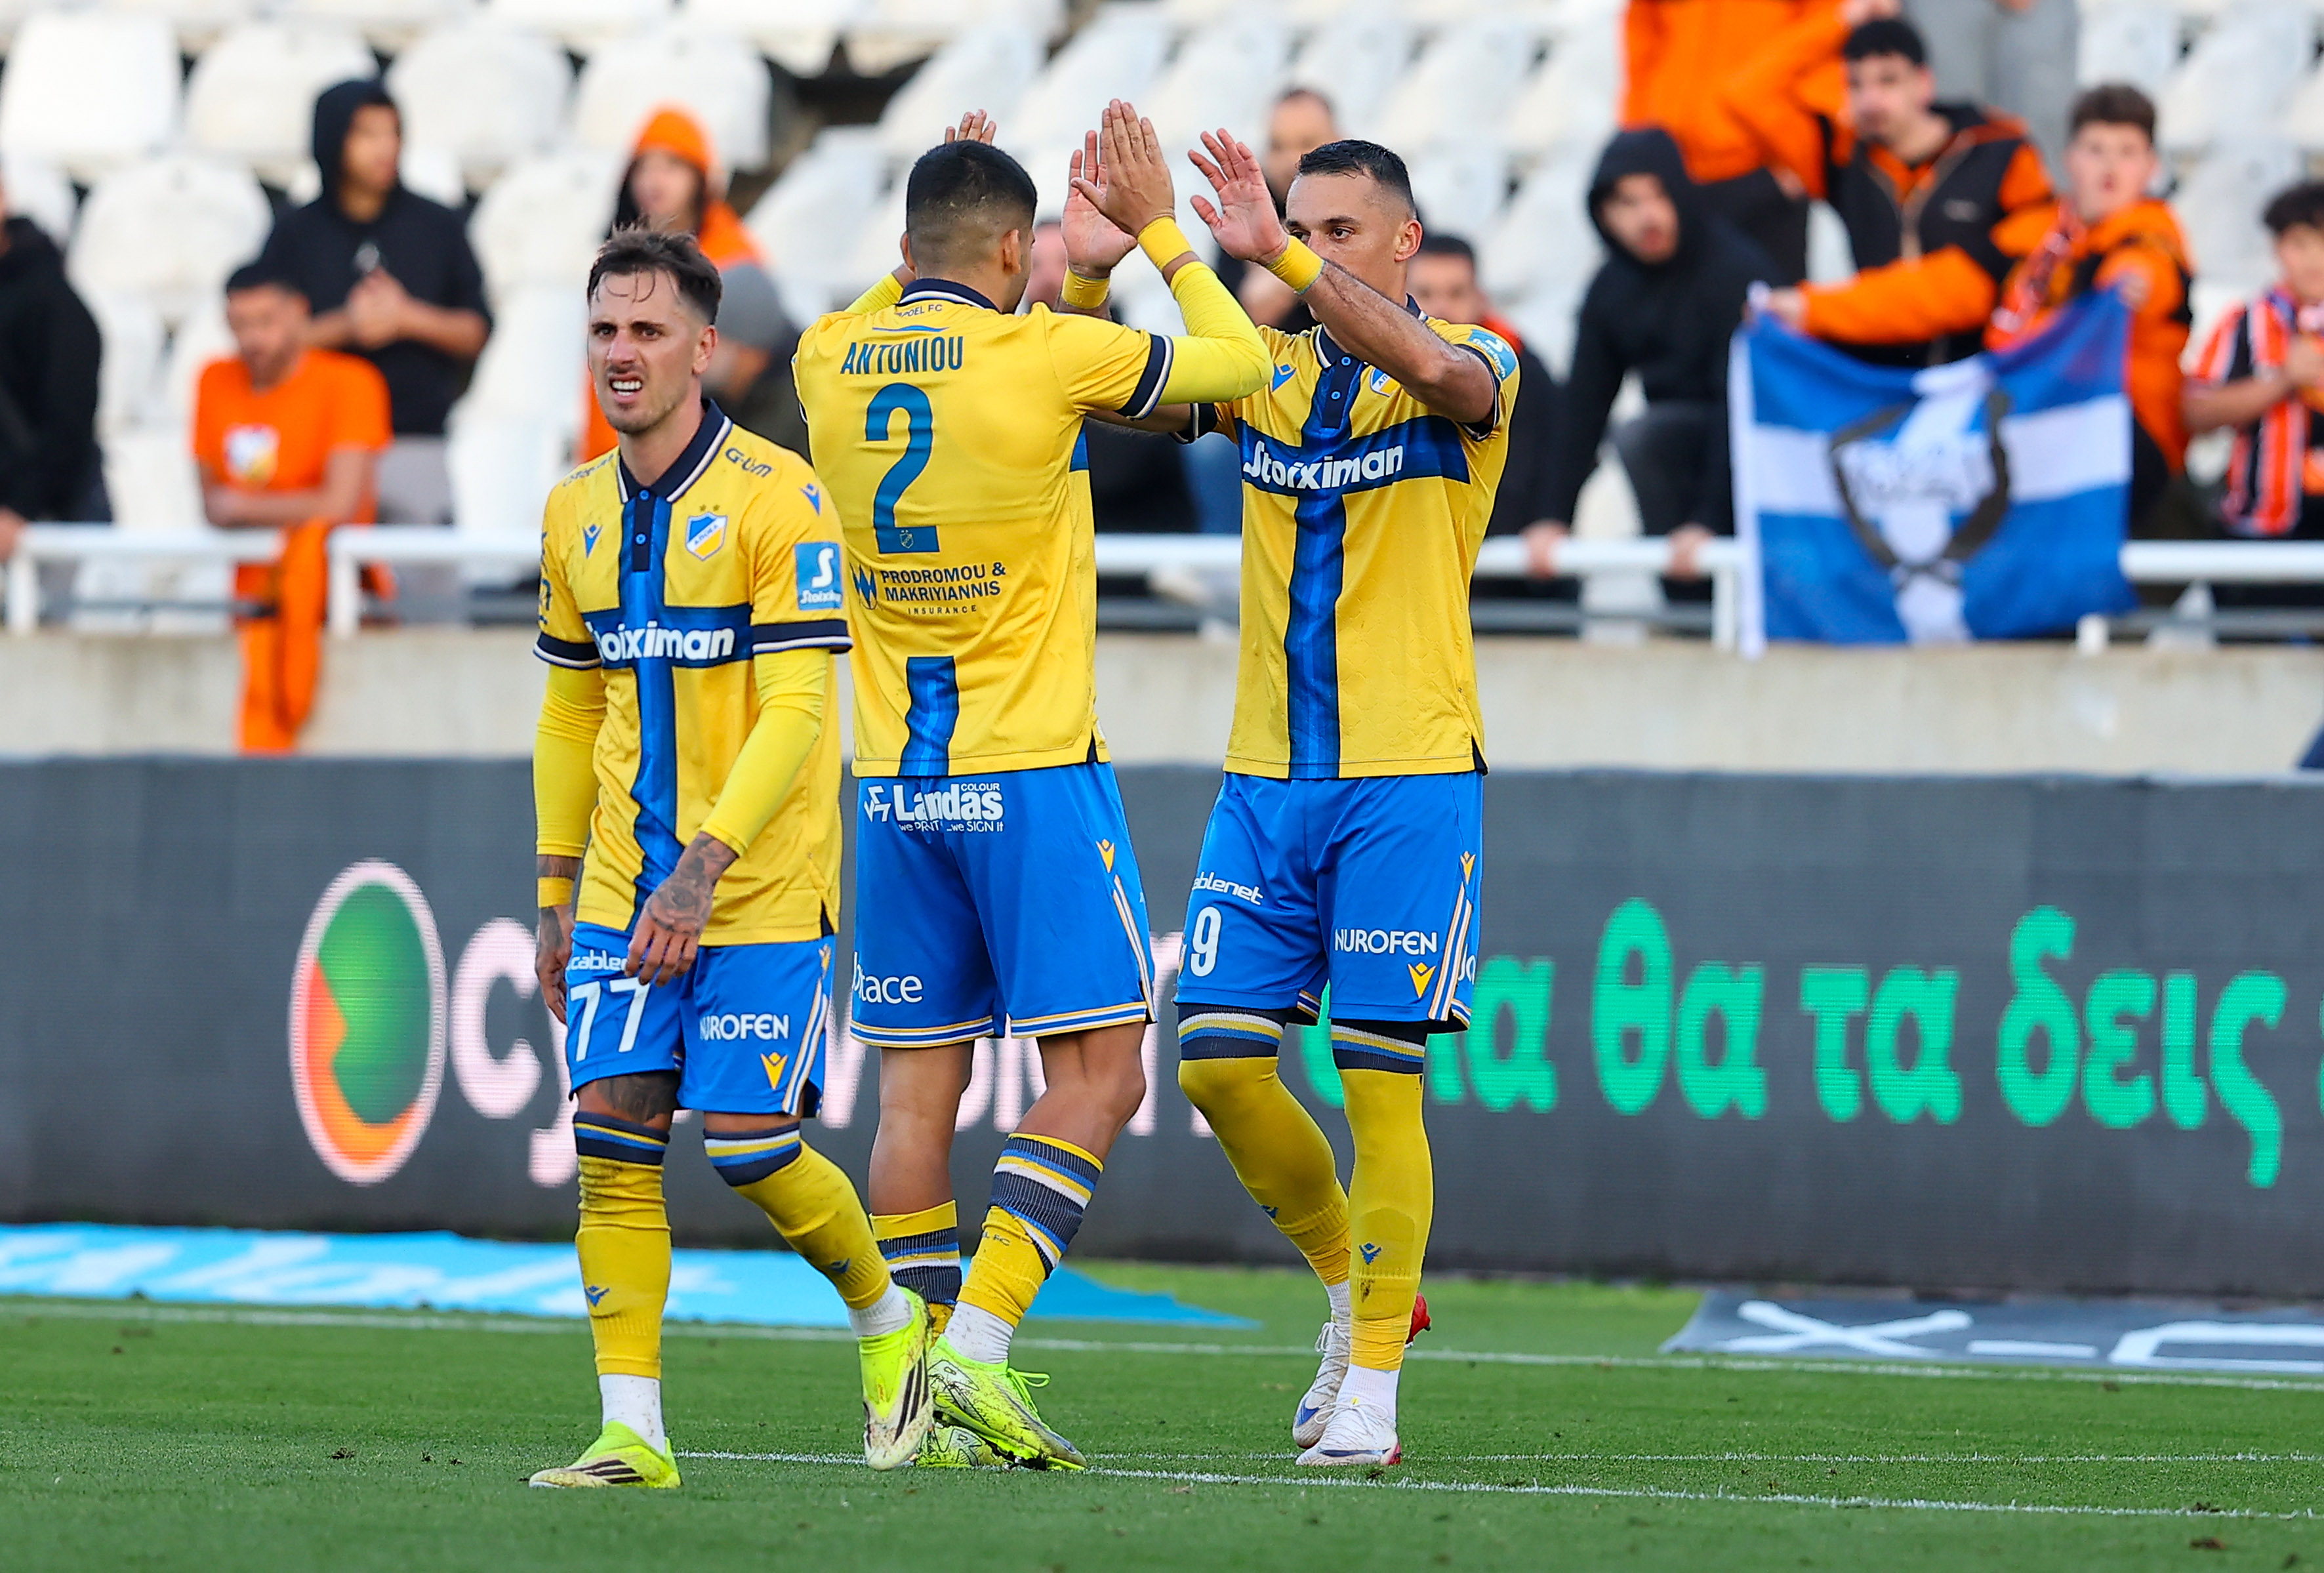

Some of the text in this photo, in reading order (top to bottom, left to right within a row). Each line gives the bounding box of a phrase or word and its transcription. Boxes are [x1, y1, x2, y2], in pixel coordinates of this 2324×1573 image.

[865, 382, 940, 554] 2
[1243, 440, 1404, 489] Stoiximan
[880, 562, 1006, 584] PRODROMOU &
[884, 581, 1001, 602] MAKRIYIANNIS
[908, 605, 977, 615] INSURANCE
[585, 621, 735, 663] oiximan
[893, 783, 1004, 821] Landas
[966, 821, 994, 832] SIGN
[1192, 872, 1263, 905] ablenet
[1334, 929, 1438, 955] NUROFEN
[570, 977, 651, 1063] 77
[1995, 905, 2289, 1189] δεις
